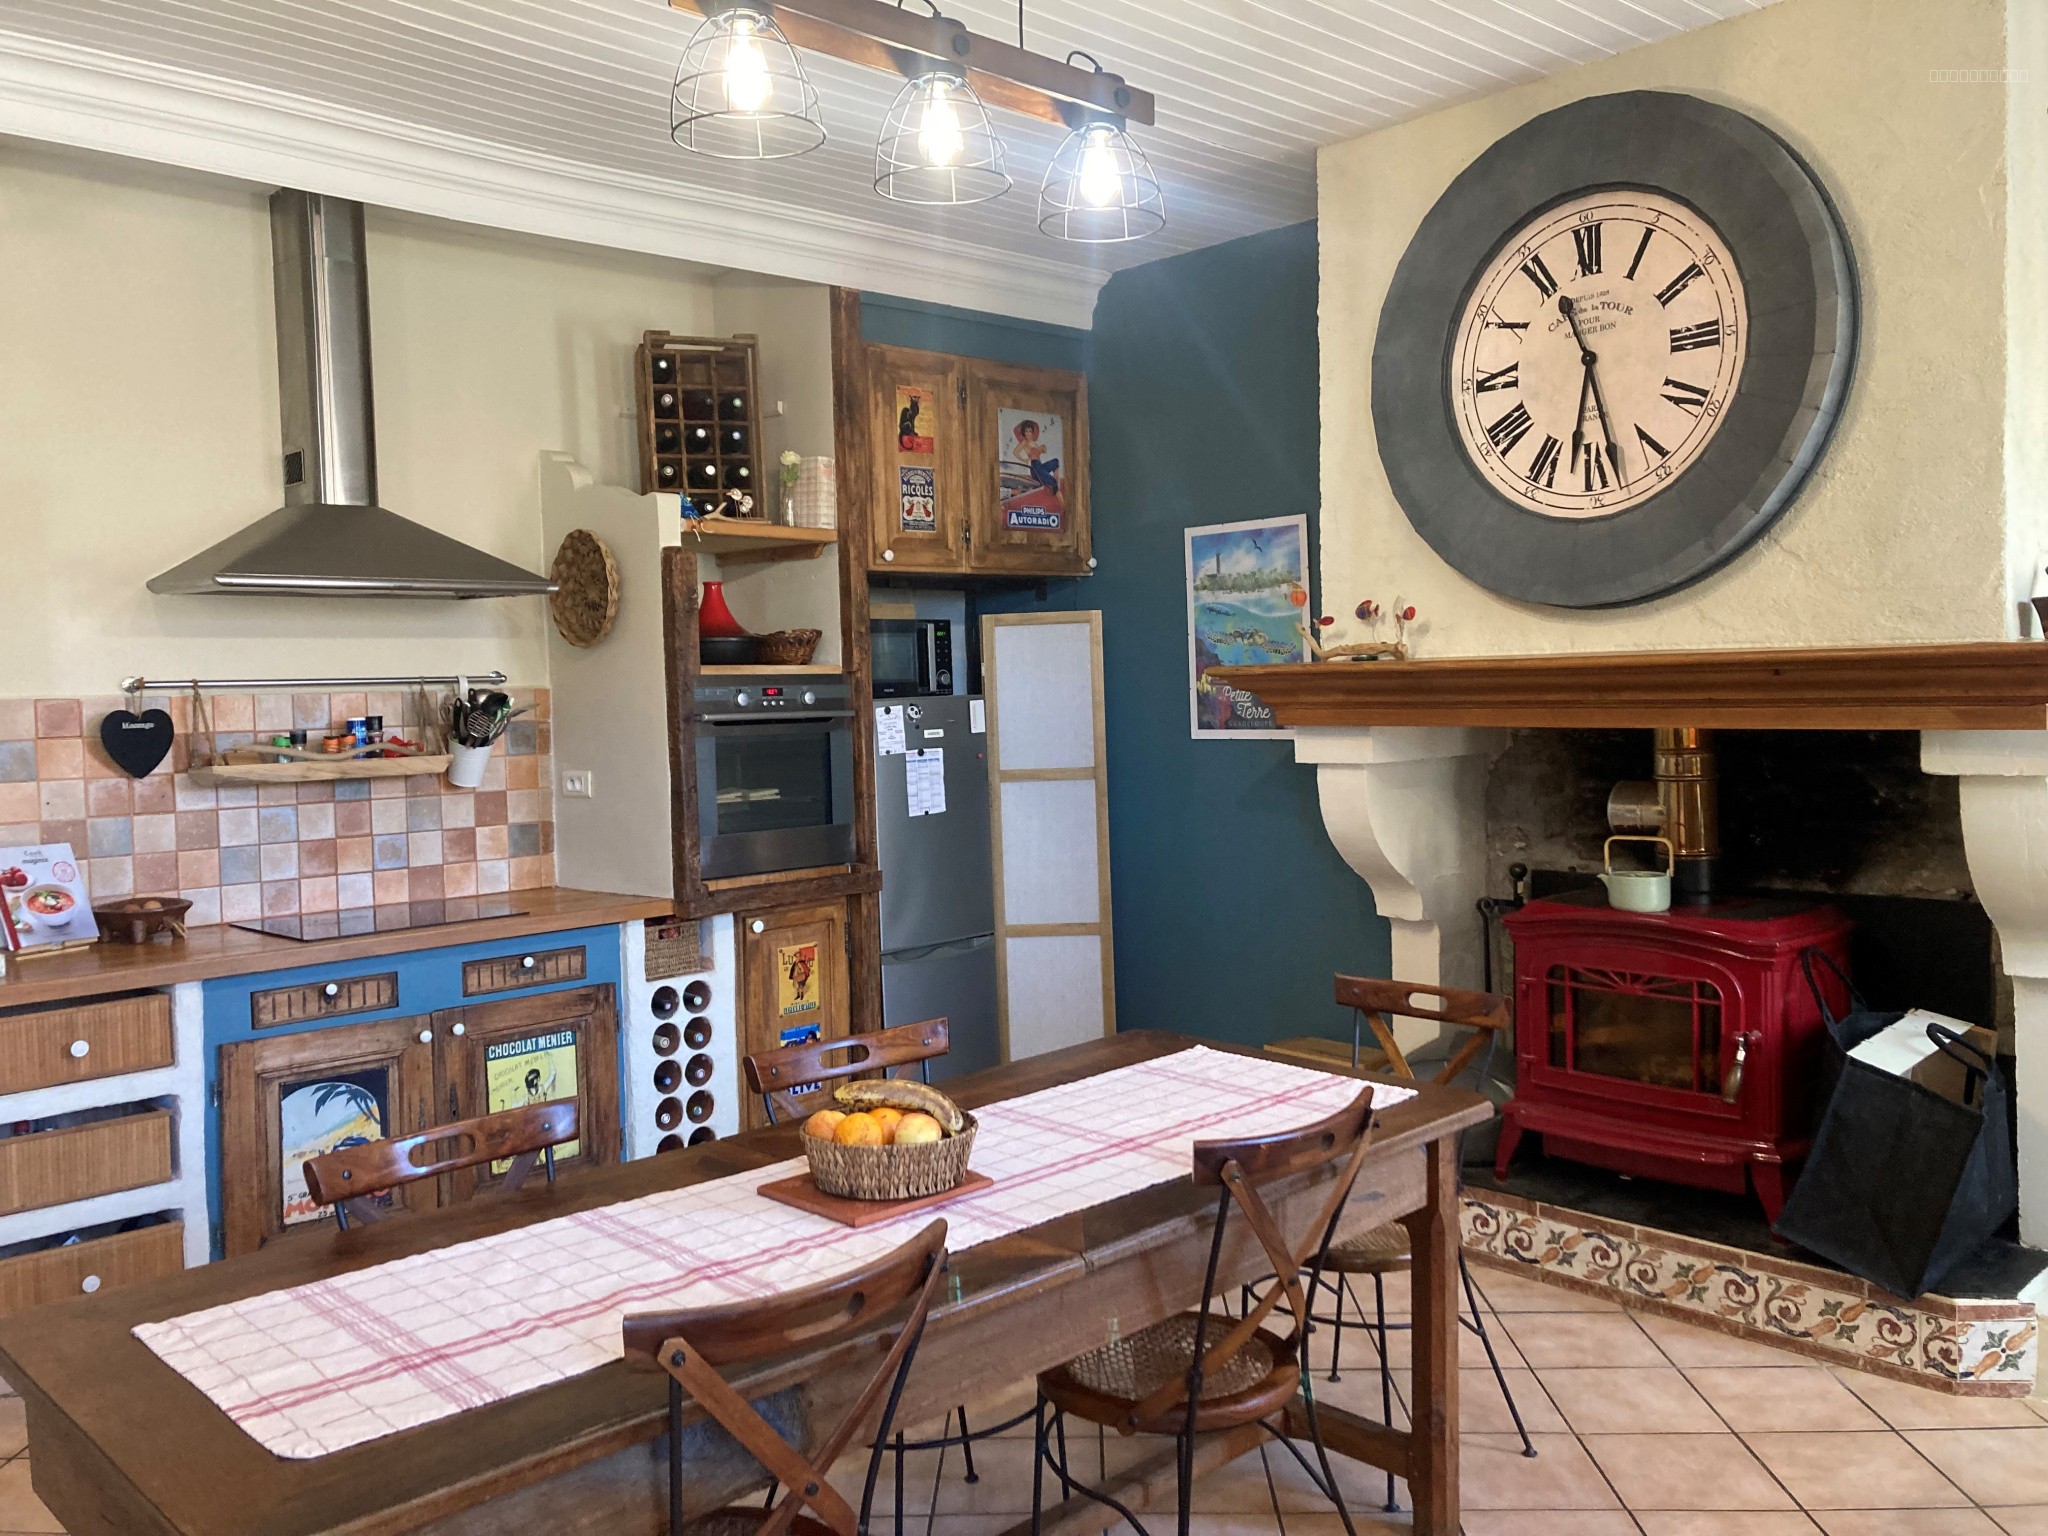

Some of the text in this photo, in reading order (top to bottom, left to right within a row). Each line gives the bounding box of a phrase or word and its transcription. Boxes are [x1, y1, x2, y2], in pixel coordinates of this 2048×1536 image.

[1578, 210, 1594, 223] 60
[1650, 211, 1662, 224] 5
[1570, 222, 1603, 282] XII
[1703, 248, 1715, 266] 10
[1477, 303, 1488, 322] 50
[1600, 301, 1634, 316] TOUR
[1578, 315, 1601, 327] POUR
[1599, 321, 1617, 332] BON
[1706, 399, 1721, 418] 20
[1023, 507, 1045, 515] PHILIPS
[1010, 512, 1058, 527] AUTORADIO
[1222, 685, 1252, 702] Petite
[1237, 702, 1271, 719] Terre
[488, 1030, 573, 1058] CHOCOLAT MENIER
[788, 1082, 821, 1096] LIVE
